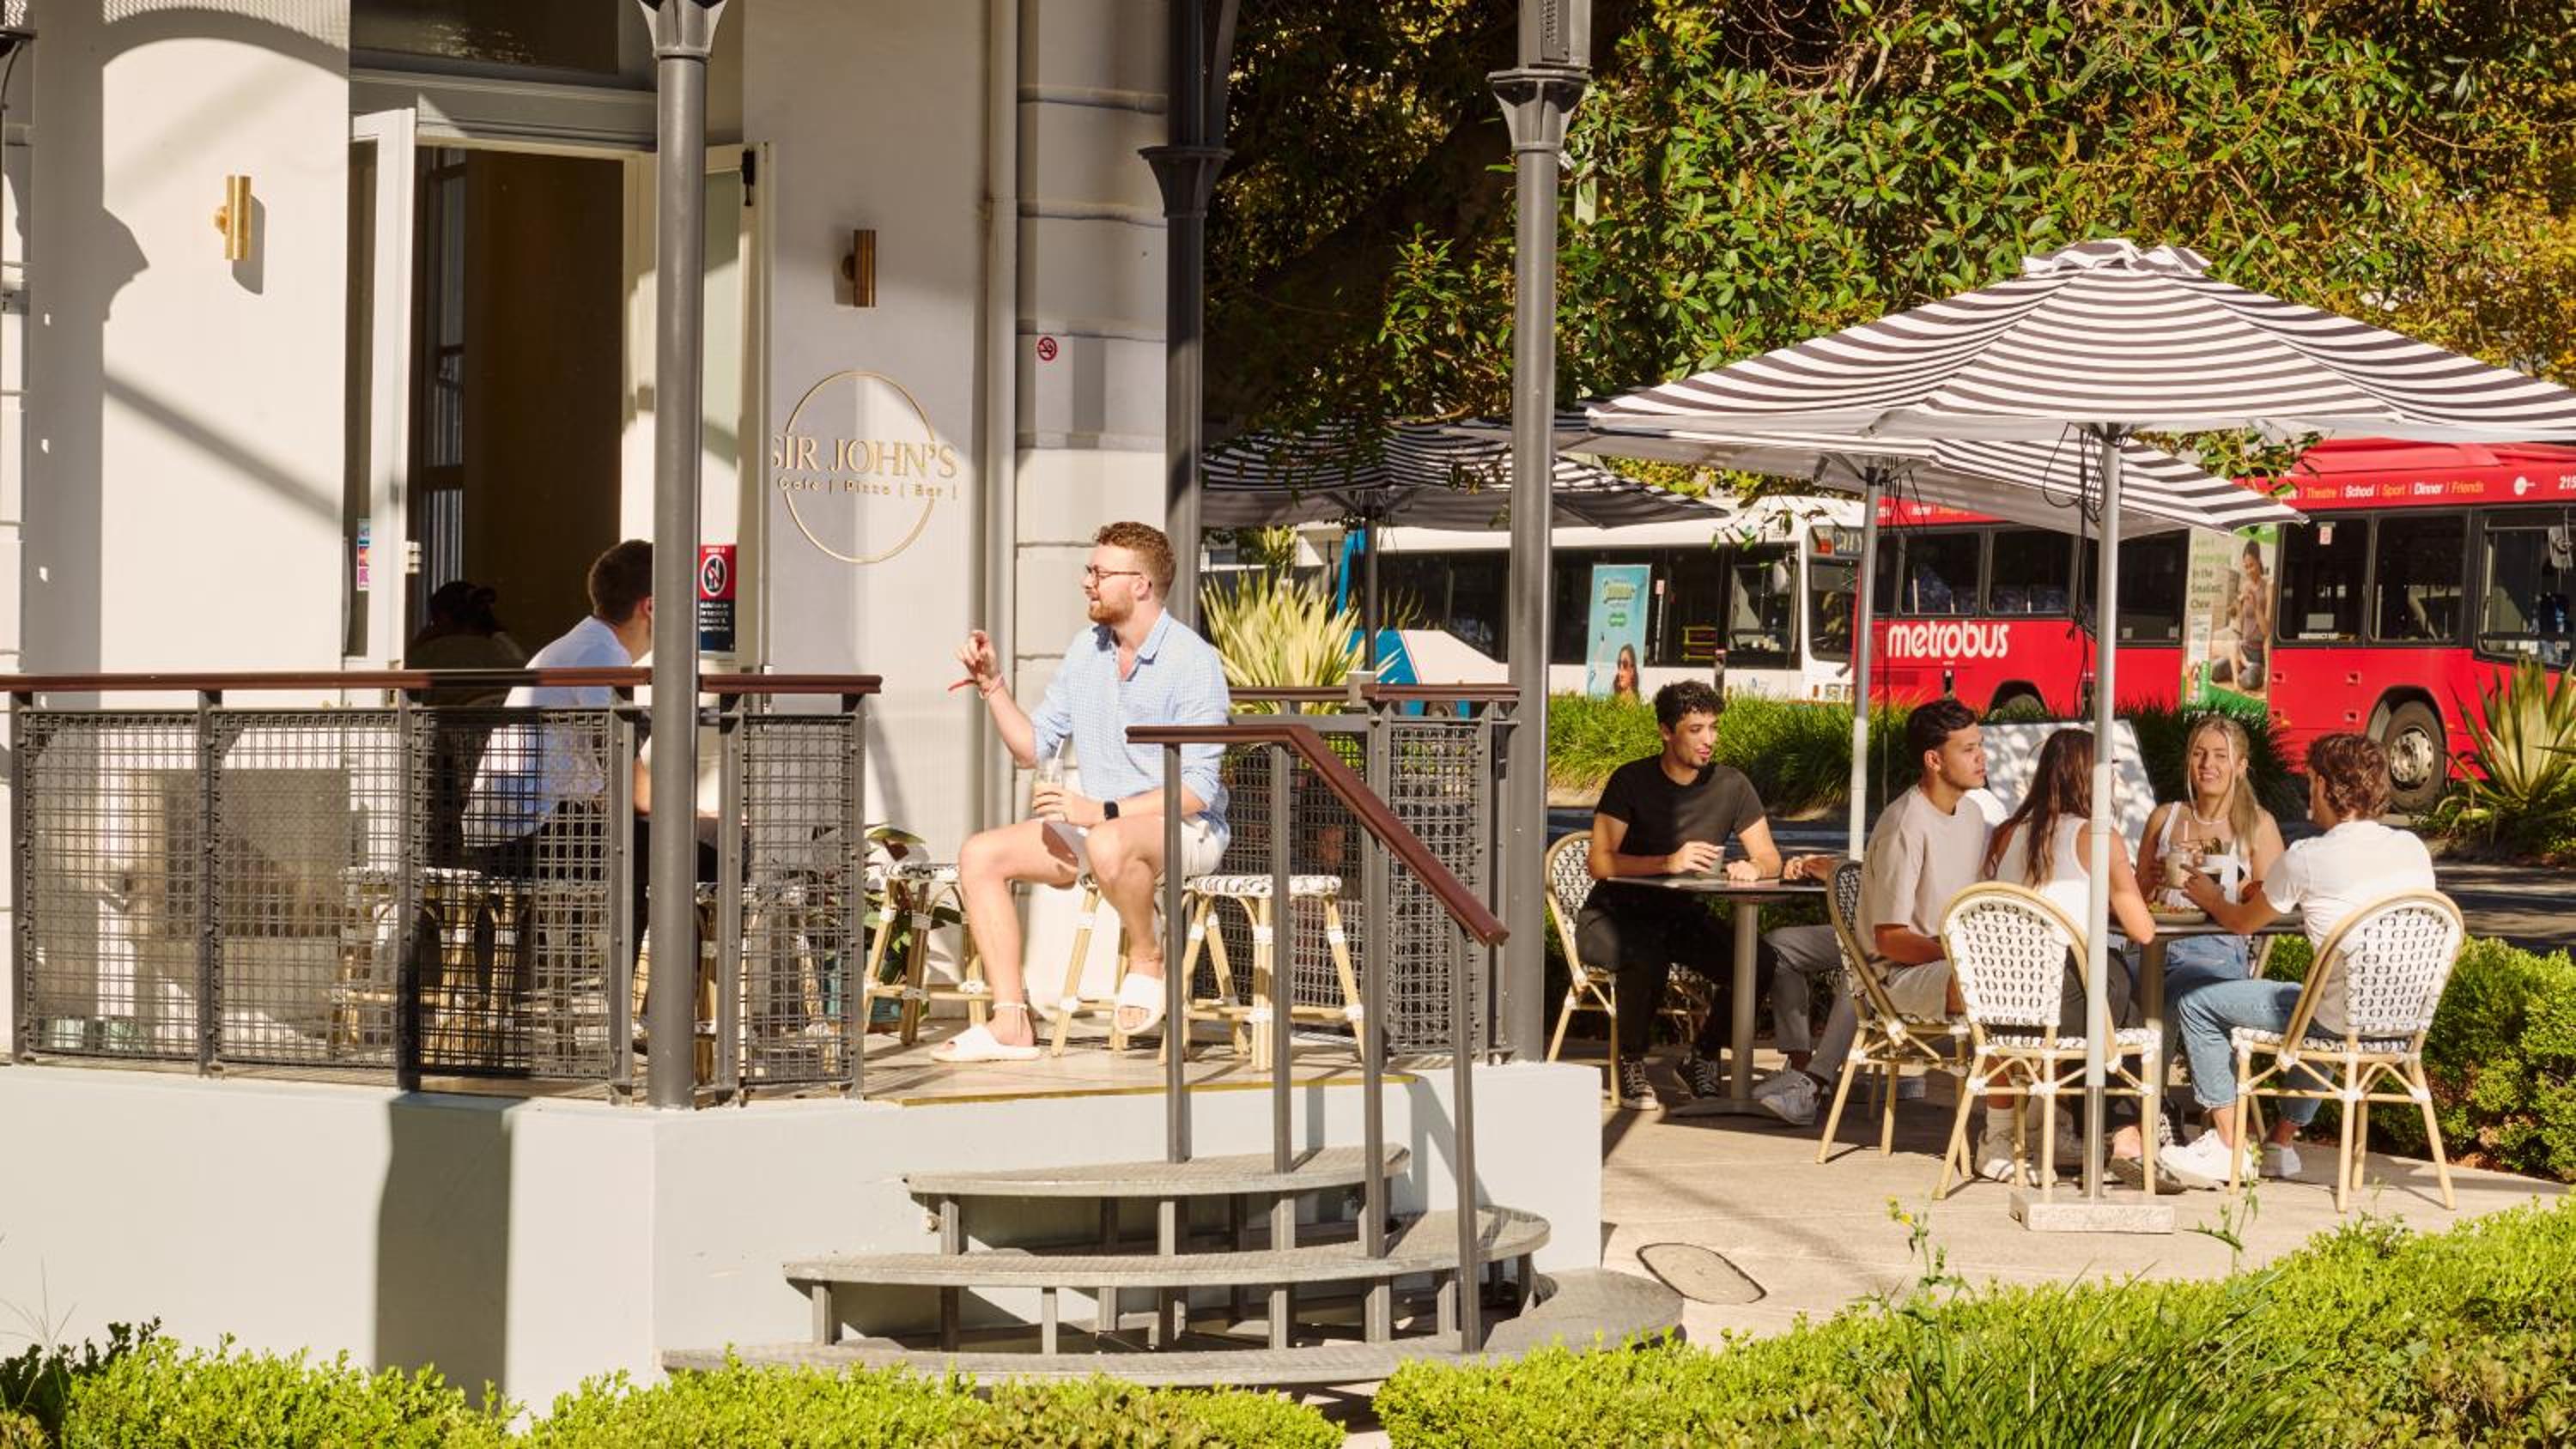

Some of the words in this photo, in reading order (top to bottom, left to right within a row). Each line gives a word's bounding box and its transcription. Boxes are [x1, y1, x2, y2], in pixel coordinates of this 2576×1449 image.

[2306, 487, 2336, 499] Theatre
[2345, 484, 2374, 498] School
[2383, 483, 2405, 497] Sport
[2414, 481, 2444, 495] Dinner
[2451, 481, 2484, 495] Friends
[1887, 621, 2010, 658] metrobus
